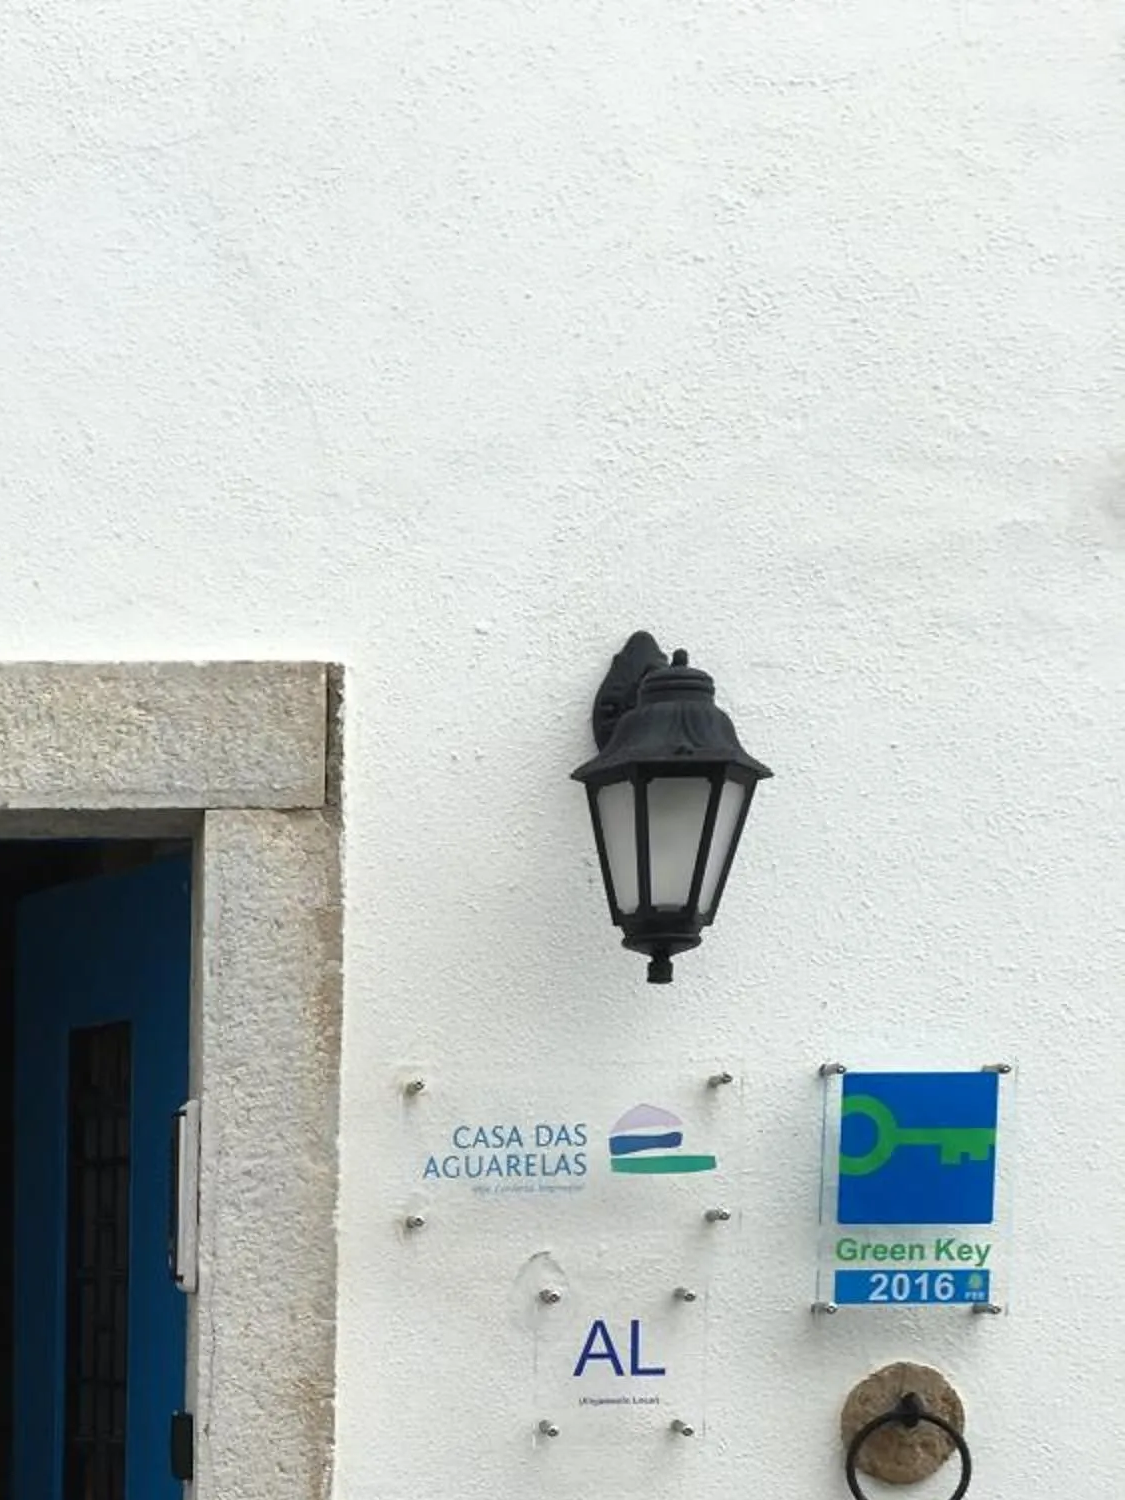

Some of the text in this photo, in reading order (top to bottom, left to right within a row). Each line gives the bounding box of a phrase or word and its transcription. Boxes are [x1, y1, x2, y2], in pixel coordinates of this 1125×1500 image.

[454, 1124, 587, 1149] CASA DAS
[424, 1154, 587, 1179] AGUARELAS
[836, 1238, 991, 1266] Green Key
[868, 1273, 955, 1301] 2016
[573, 1319, 666, 1376] AL
